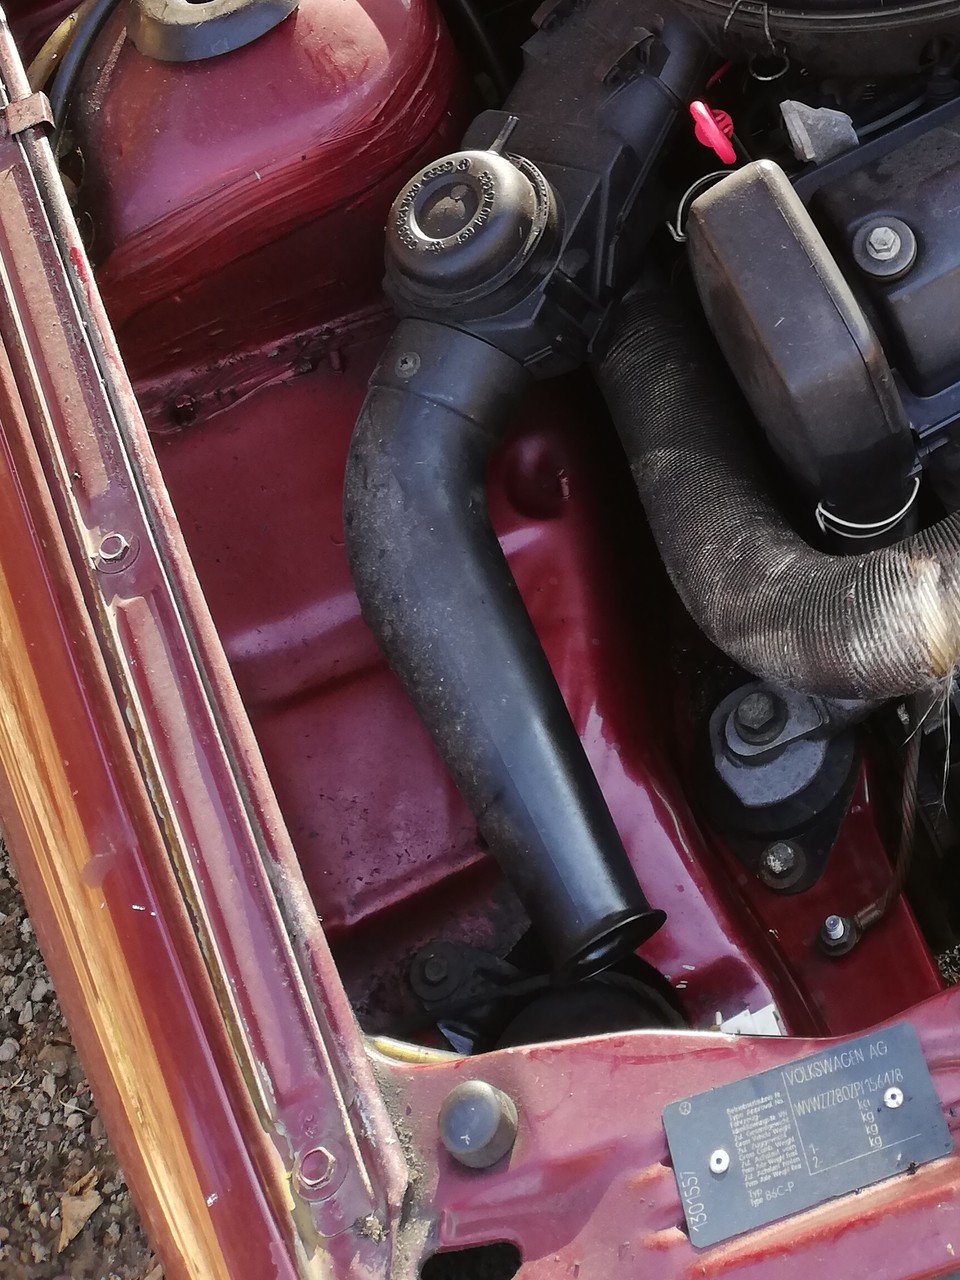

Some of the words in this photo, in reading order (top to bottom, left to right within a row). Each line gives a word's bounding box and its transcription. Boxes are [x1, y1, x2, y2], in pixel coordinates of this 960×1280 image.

[785, 1049, 864, 1085] VOLKSWAGEN
[867, 1040, 888, 1058] AG
[861, 1110, 874, 1123] kg
[865, 1122, 878, 1136] kg
[868, 1134, 882, 1148] kg
